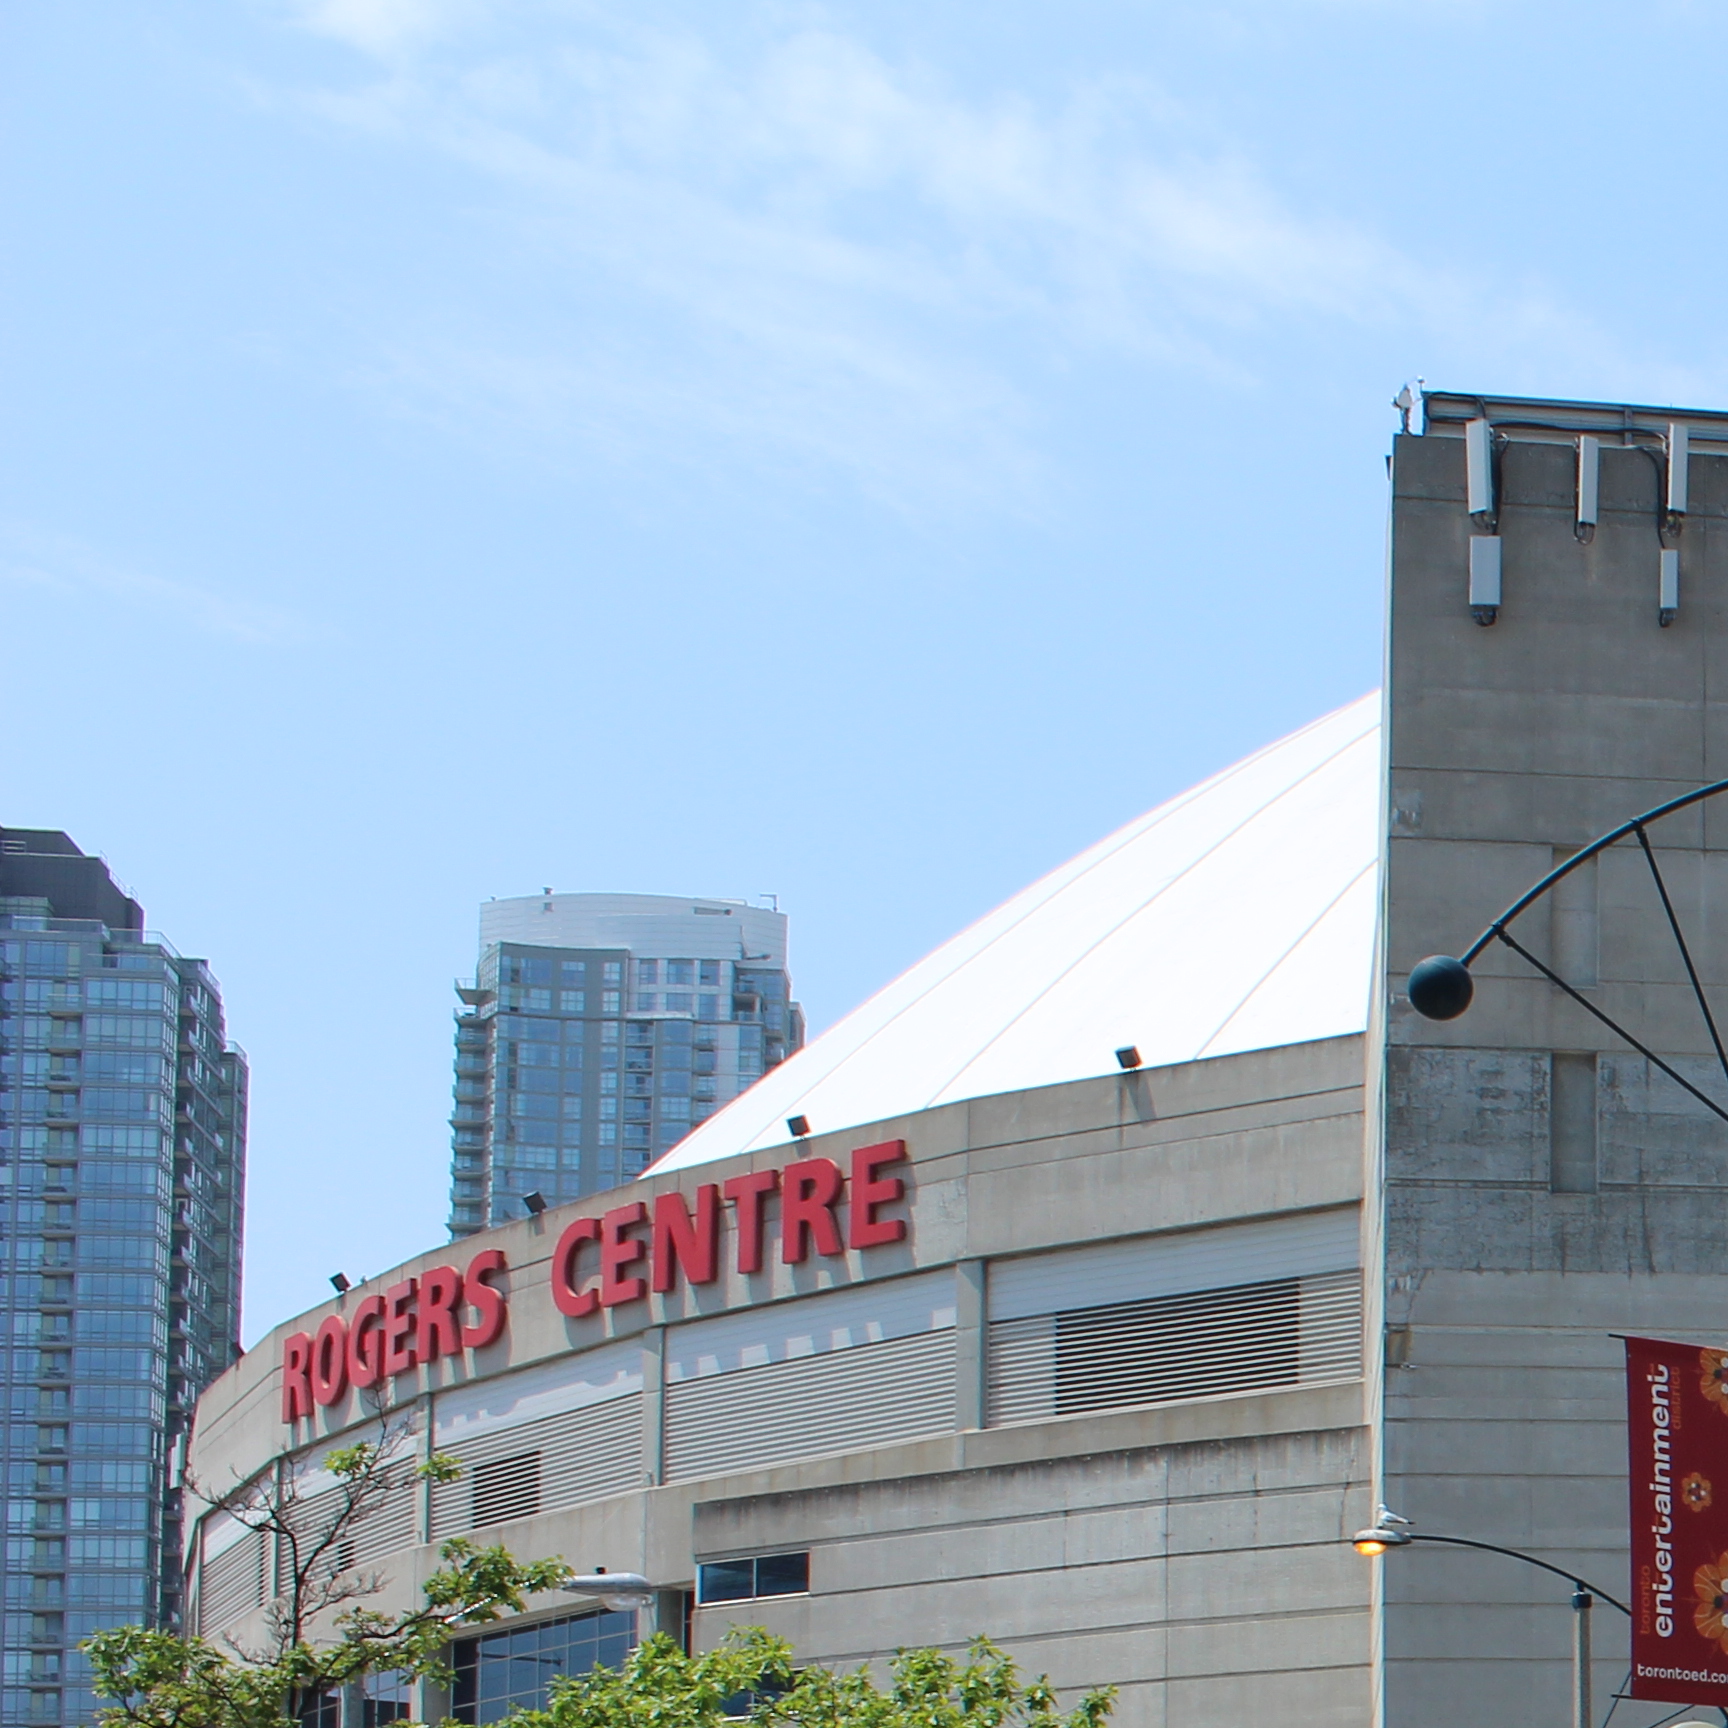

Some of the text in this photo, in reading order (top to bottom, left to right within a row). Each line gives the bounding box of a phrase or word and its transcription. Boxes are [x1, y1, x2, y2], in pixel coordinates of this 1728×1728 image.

[281, 1139, 906, 1424] ROGERS CENTRE
[1640, 1565, 1650, 1636] toronto
[1647, 1364, 1674, 1638] entertainment
